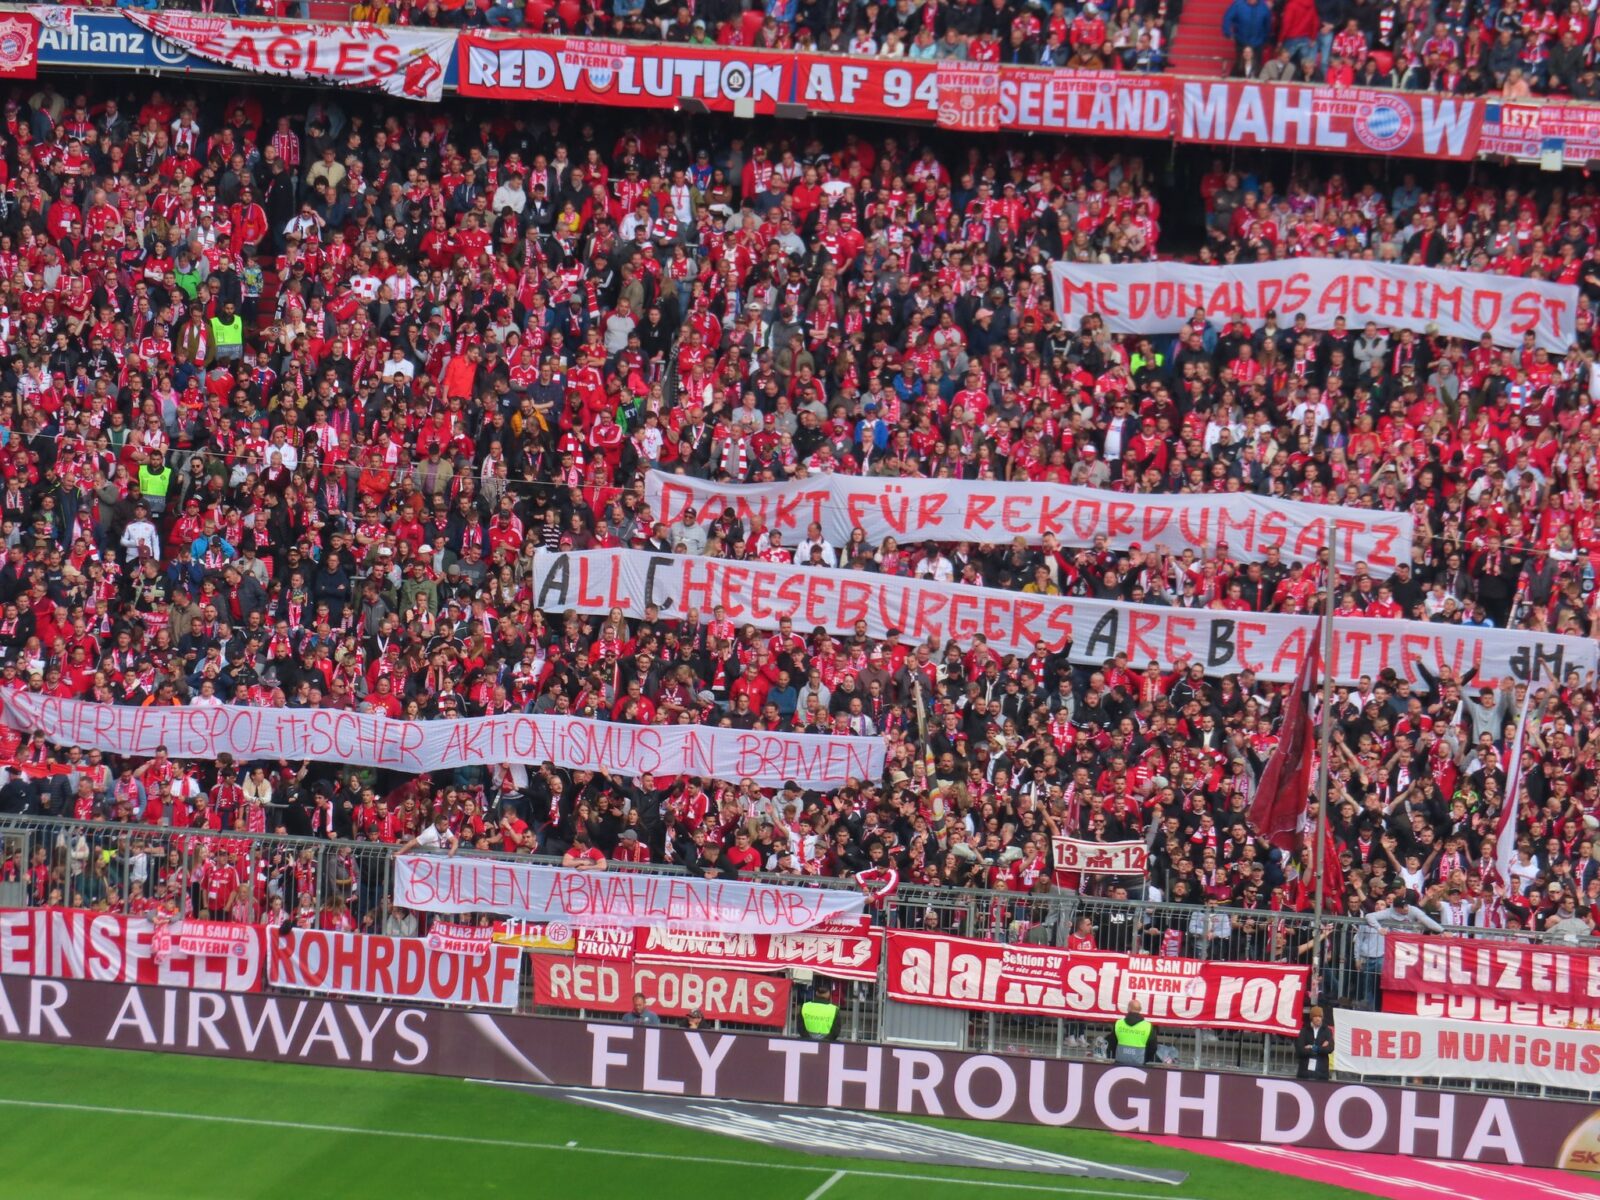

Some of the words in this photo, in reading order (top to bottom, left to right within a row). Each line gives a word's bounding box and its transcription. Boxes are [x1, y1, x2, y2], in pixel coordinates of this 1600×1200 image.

[38, 24, 144, 54] Allianz
[565, 53, 609, 68] BAYERN
[805, 63, 867, 103] AF
[883, 68, 939, 111] 94
[937, 74, 980, 86] BAYERN
[1053, 81, 1096, 93] BAYERN
[1000, 80, 1168, 132] SEELAND
[1128, 273, 1311, 320] DONALDS
[1317, 273, 1463, 318] ACHIM
[1473, 289, 1567, 337] OST
[659, 481, 831, 529] DANKT
[848, 484, 949, 536] FÜR
[963, 492, 1400, 567] REKORDUMSATZ
[539, 553, 631, 610] ALL
[645, 557, 1074, 654] CHEESEBURGERS
[1085, 606, 1198, 664] ARE
[1055, 843, 1079, 866] 13
[1121, 846, 1147, 869] 12
[404, 858, 531, 912] BULLEN
[181, 939, 229, 954] BAYERN
[182, 923, 204, 936] MIA
[207, 925, 228, 939] SAN
[578, 925, 634, 946] LAND
[577, 941, 632, 959] FRONT
[1003, 950, 1045, 967] Sektion
[1046, 956, 1062, 969] SV
[1129, 957, 1153, 972] MIA
[1156, 958, 1180, 974] SAN
[270, 929, 520, 1004] ROHRDORF
[1394, 941, 1571, 994] POLIZEI
[550, 963, 620, 1003] RED
[635, 969, 776, 1017] COBRAS
[1128, 976, 1181, 993] BAYERN
[1214, 974, 1302, 1027] rot
[106, 985, 430, 1067] AIRWAYS
[1351, 1028, 1421, 1059] RED
[586, 1022, 737, 1096] FLY
[768, 1037, 1220, 1138] THROUGH
[1256, 1077, 1525, 1165] DOHA
